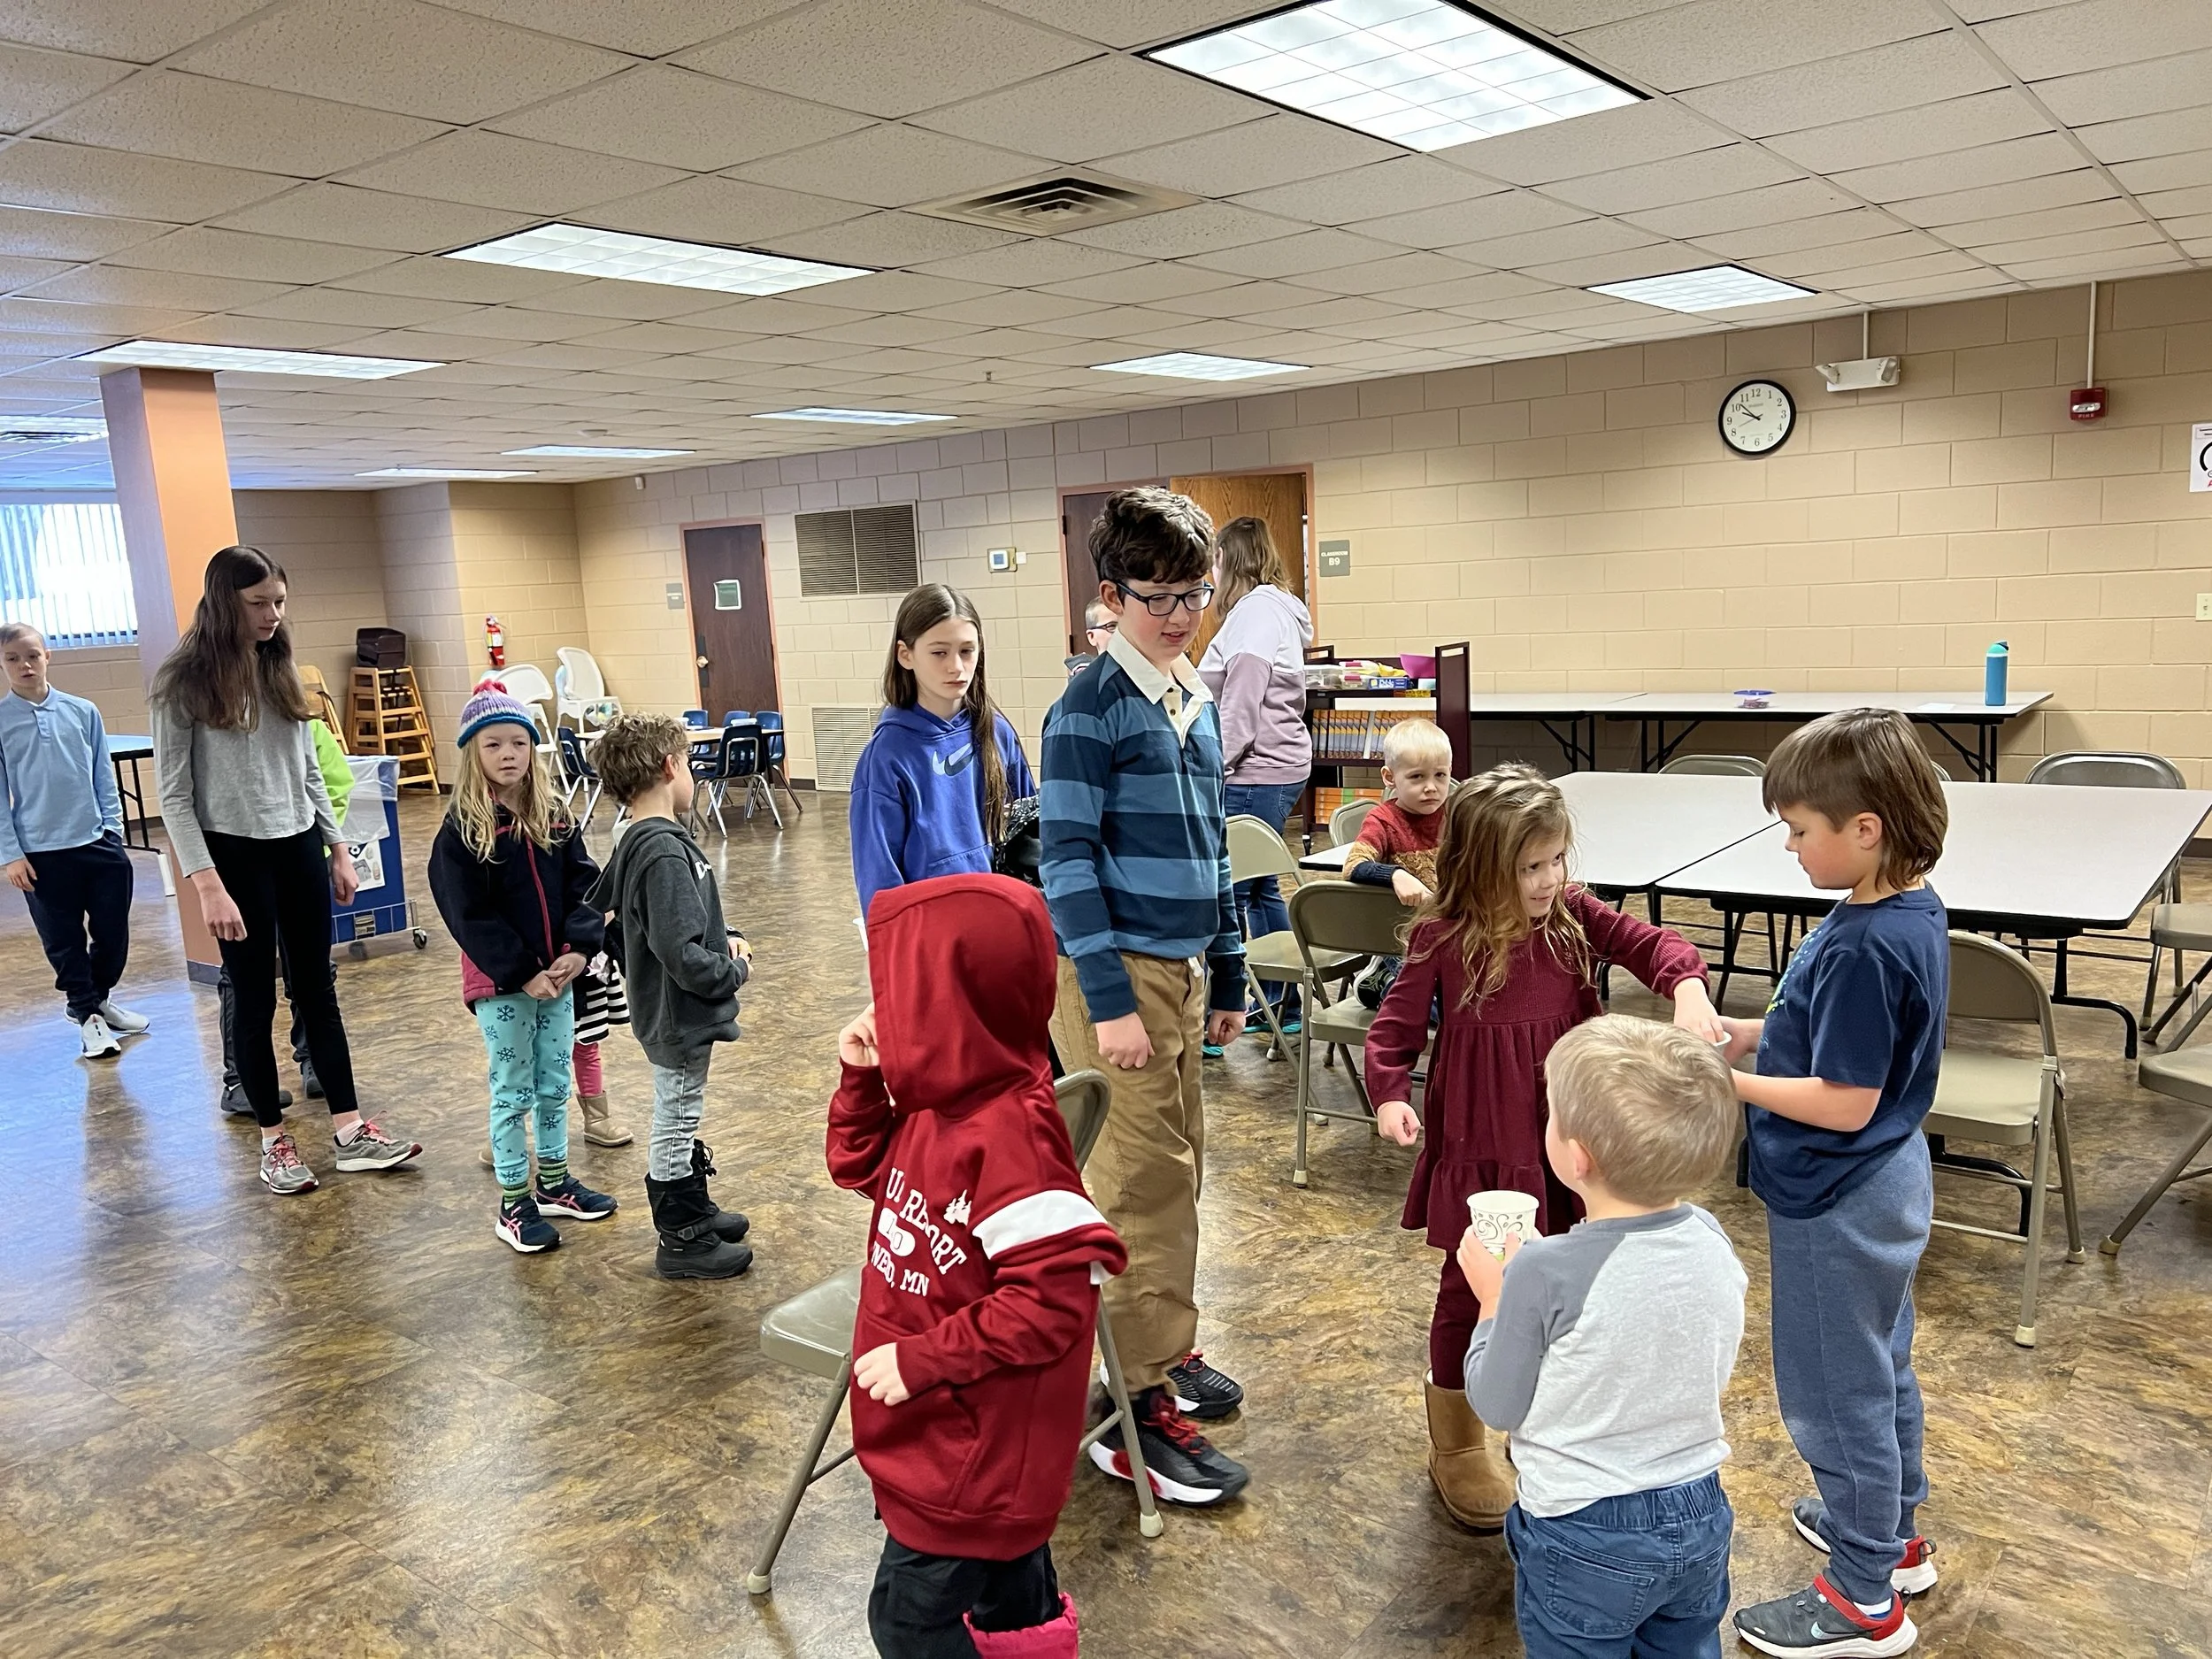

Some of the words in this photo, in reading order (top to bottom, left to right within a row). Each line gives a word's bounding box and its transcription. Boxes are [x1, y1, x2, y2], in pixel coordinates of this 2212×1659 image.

[1751, 388, 1761, 397] 12
[1768, 390, 1772, 399] 1
[1328, 557, 1340, 566] B9
[899, 1188, 968, 1275] REORT
[899, 1269, 930, 1297] MN
